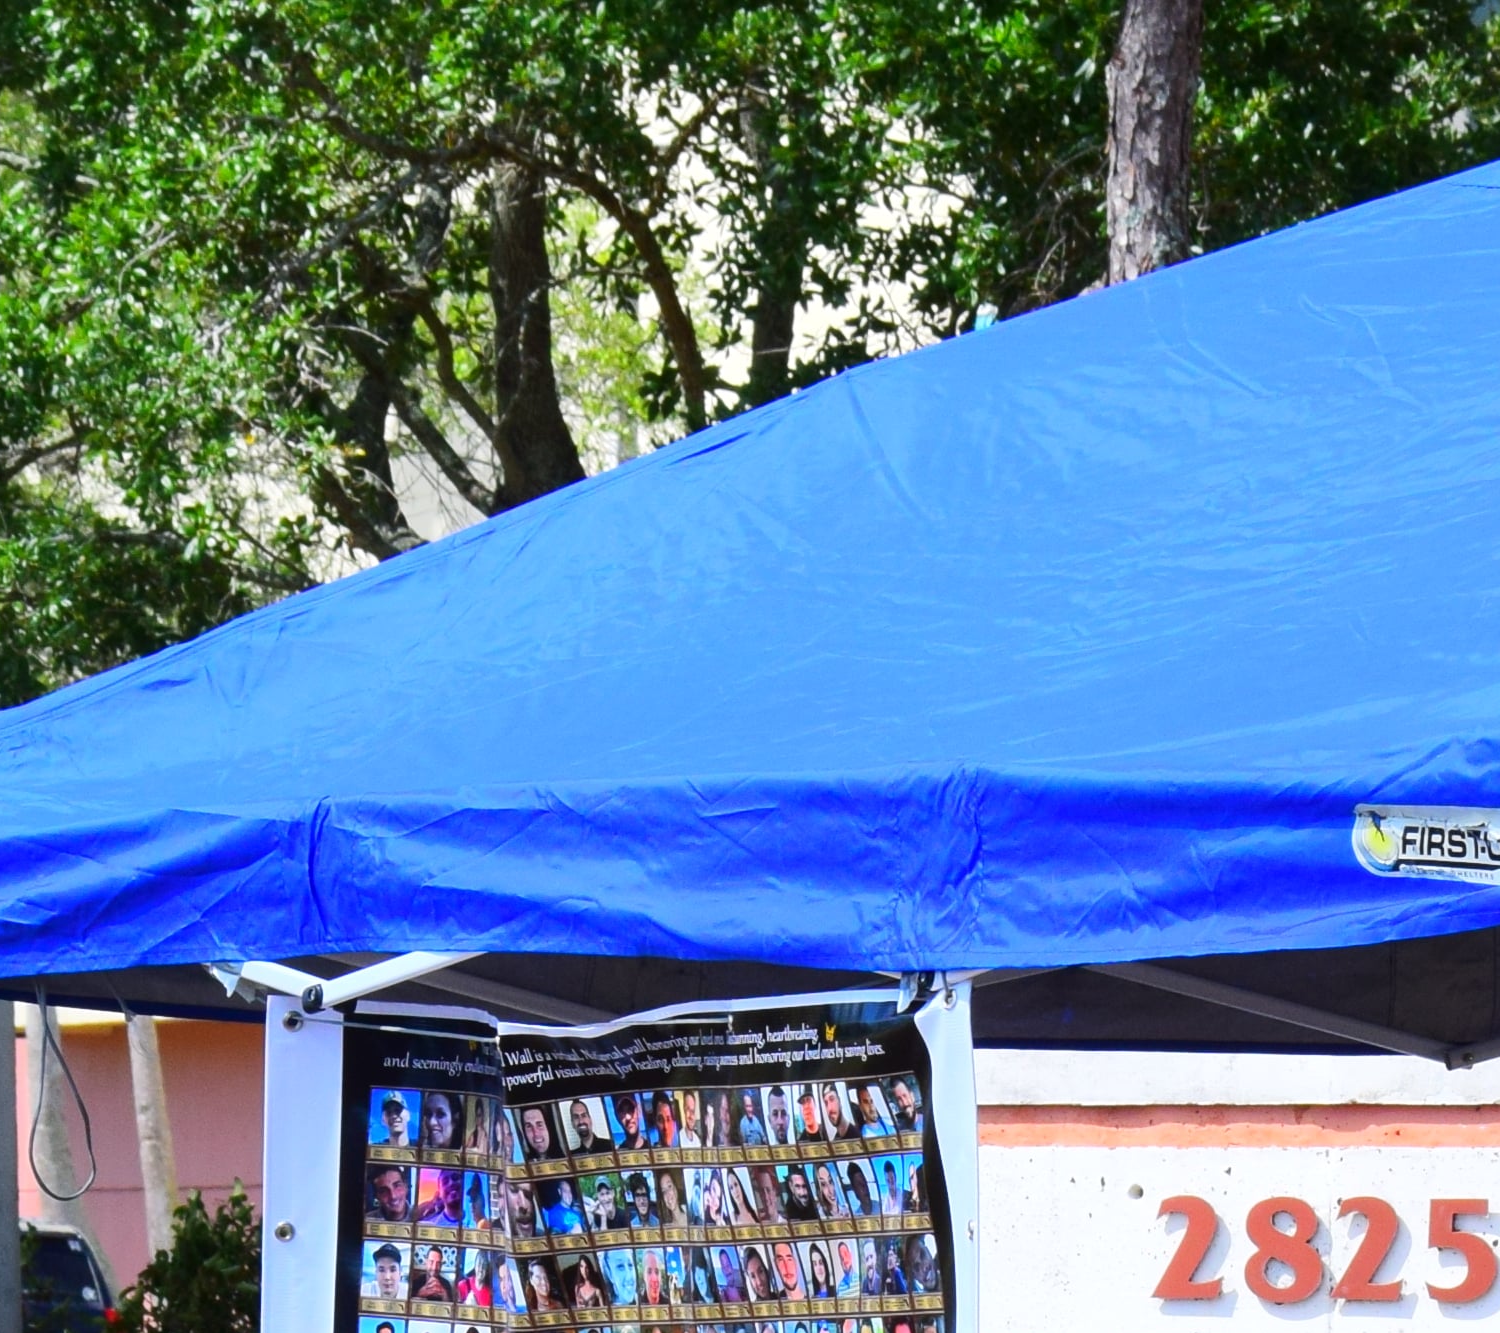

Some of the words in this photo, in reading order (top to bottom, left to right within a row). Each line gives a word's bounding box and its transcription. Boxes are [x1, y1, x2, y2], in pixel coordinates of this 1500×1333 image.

[505, 1051, 534, 1066] Wall
[622, 1037, 647, 1056] wall
[643, 1034, 689, 1051] honoring
[383, 1052, 409, 1068] and
[411, 1054, 463, 1077] seemingly
[505, 1065, 554, 1093] powerful
[555, 1064, 585, 1080] visual
[614, 1061, 633, 1080] for
[1151, 1194, 1499, 1304] 2825
